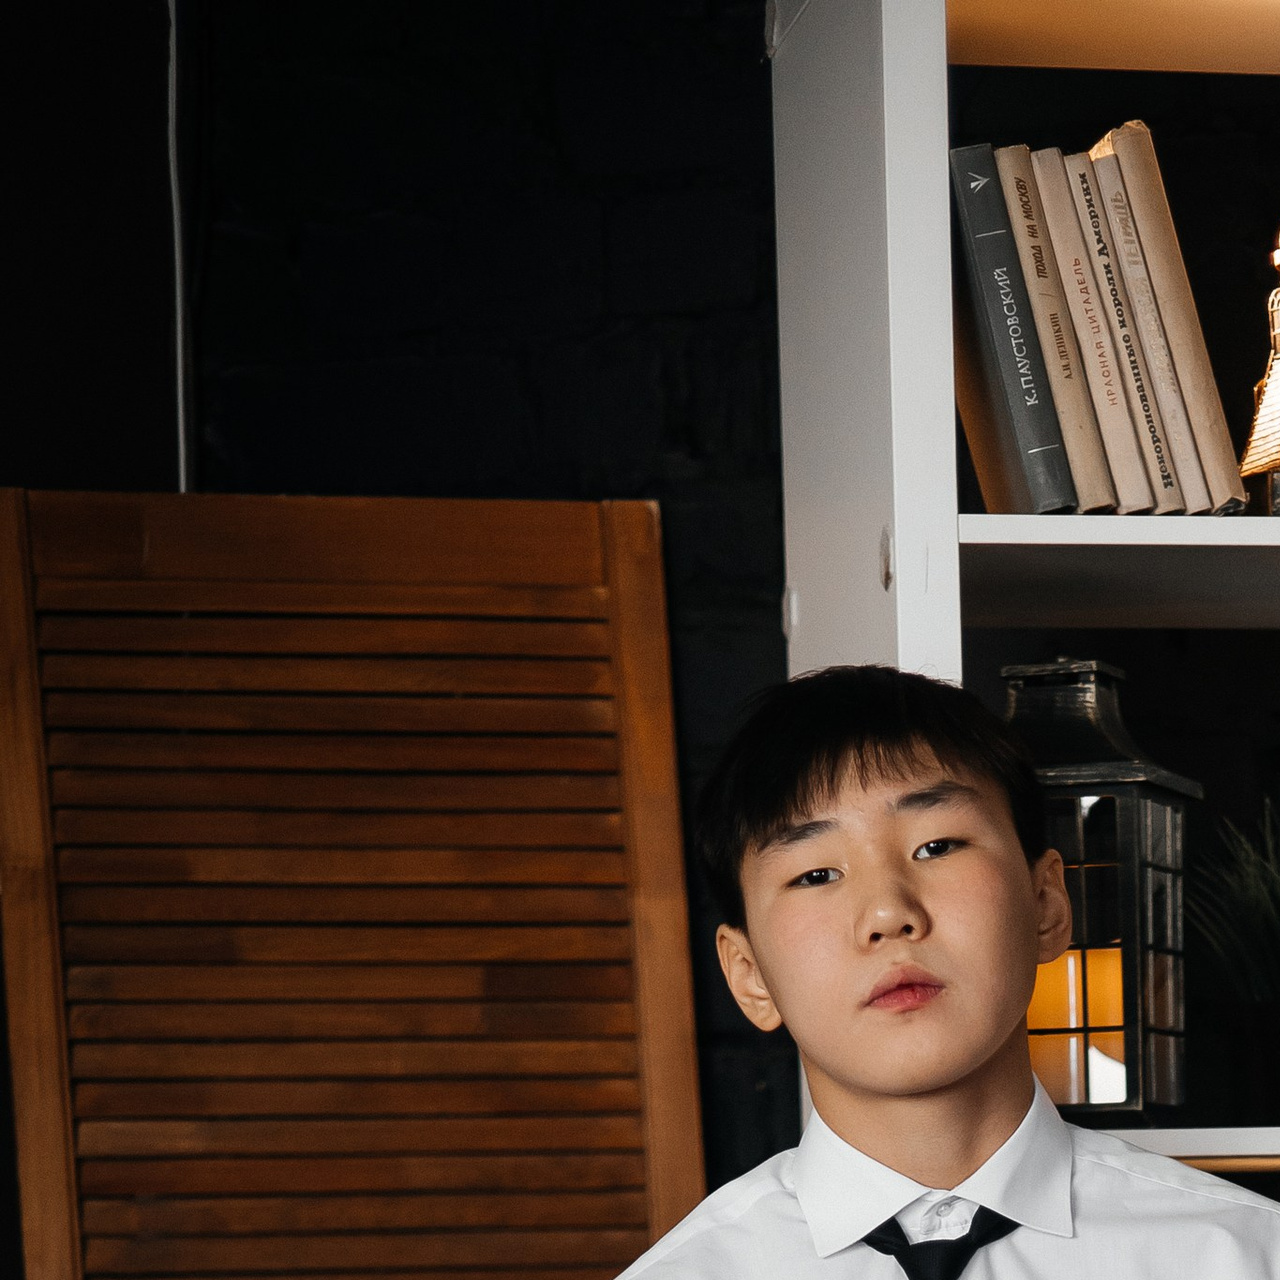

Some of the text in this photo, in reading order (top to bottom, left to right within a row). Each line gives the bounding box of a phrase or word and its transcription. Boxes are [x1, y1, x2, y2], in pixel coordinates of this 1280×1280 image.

[1012, 174, 1049, 280] ПОХОД НА МОСКВУ
[1074, 171, 1108, 262] Америки
[1070, 256, 1118, 406] КРАСНАЯ ЦИТАДЕЛЬ
[1099, 261, 1128, 330] короли
[1118, 333, 1174, 489] Некоронованные
